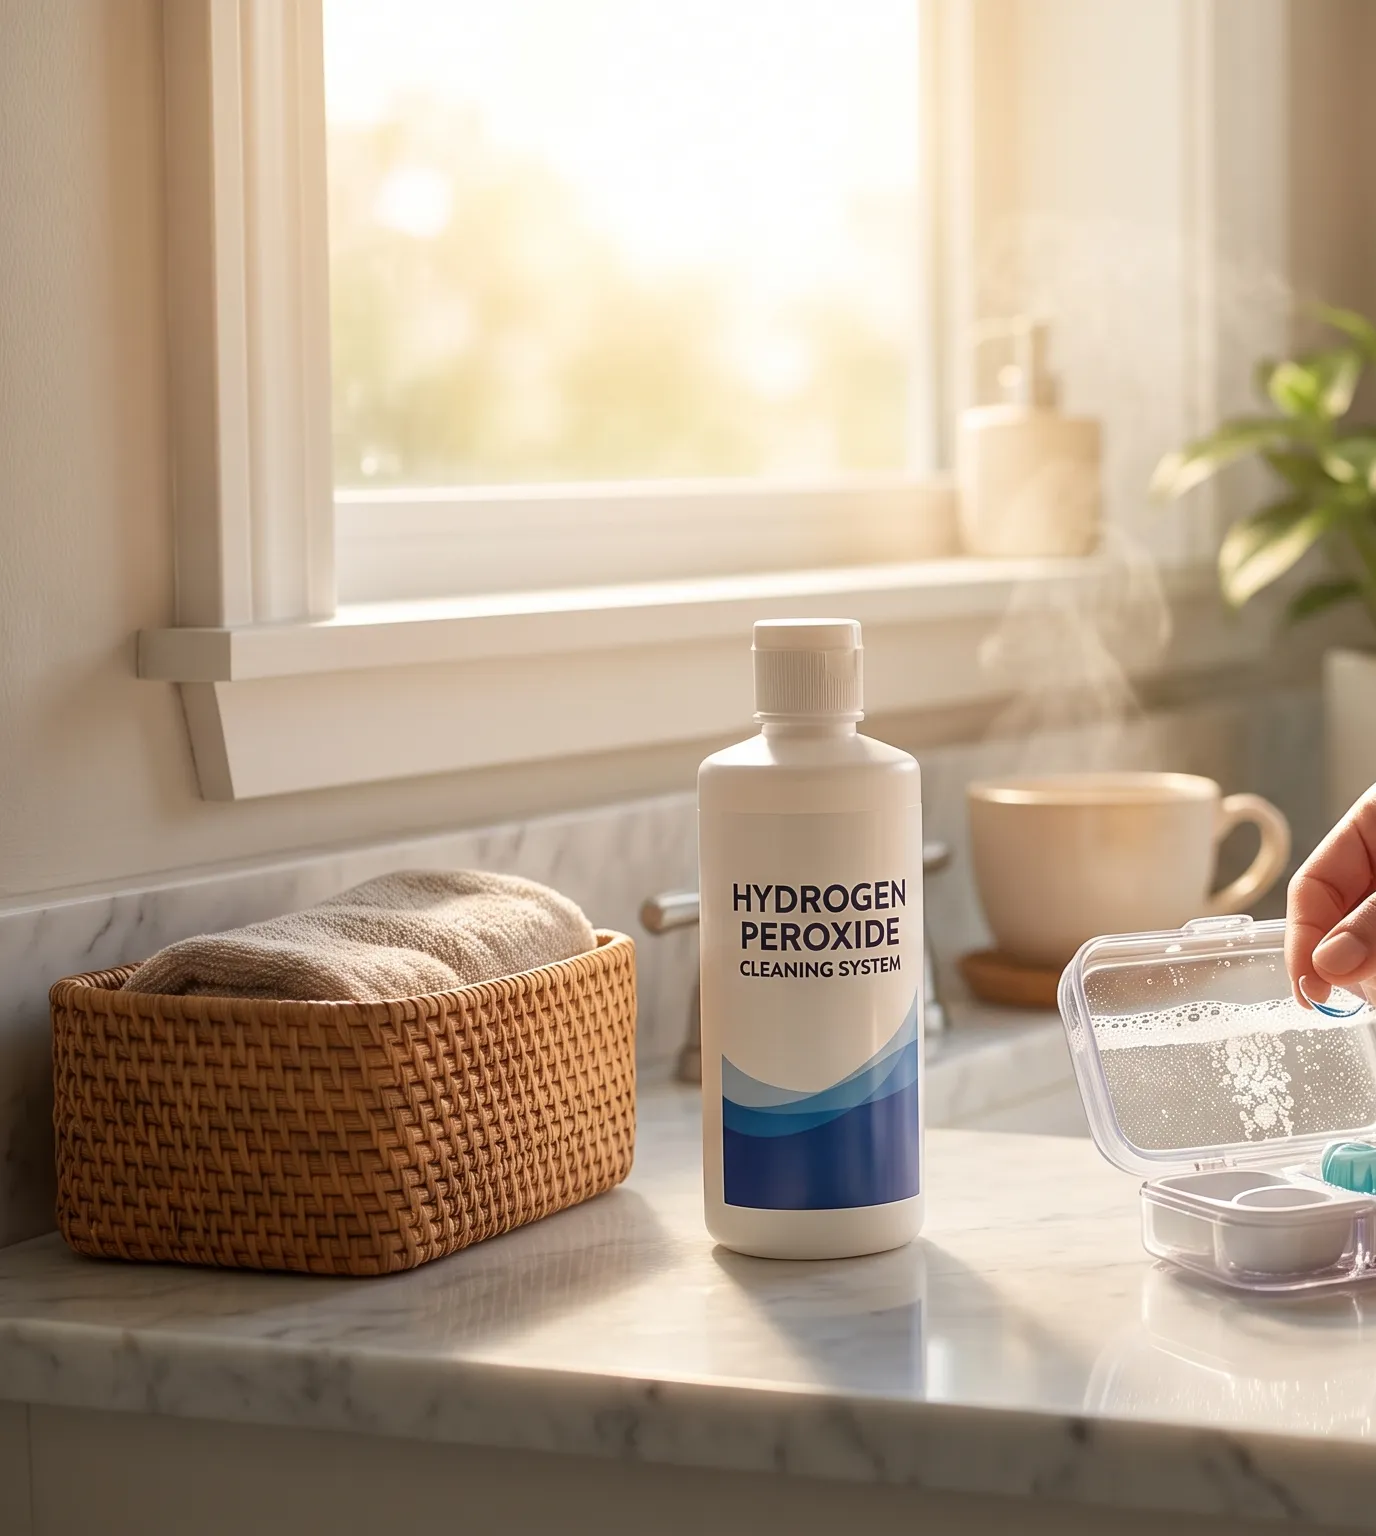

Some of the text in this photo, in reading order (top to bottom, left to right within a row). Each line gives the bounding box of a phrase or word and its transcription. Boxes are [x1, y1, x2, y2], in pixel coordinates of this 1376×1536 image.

[732, 878, 906, 914] HYDROGEN
[741, 916, 900, 952] PEROXIDE
[739, 954, 901, 979] CLEANING SYSTEM
